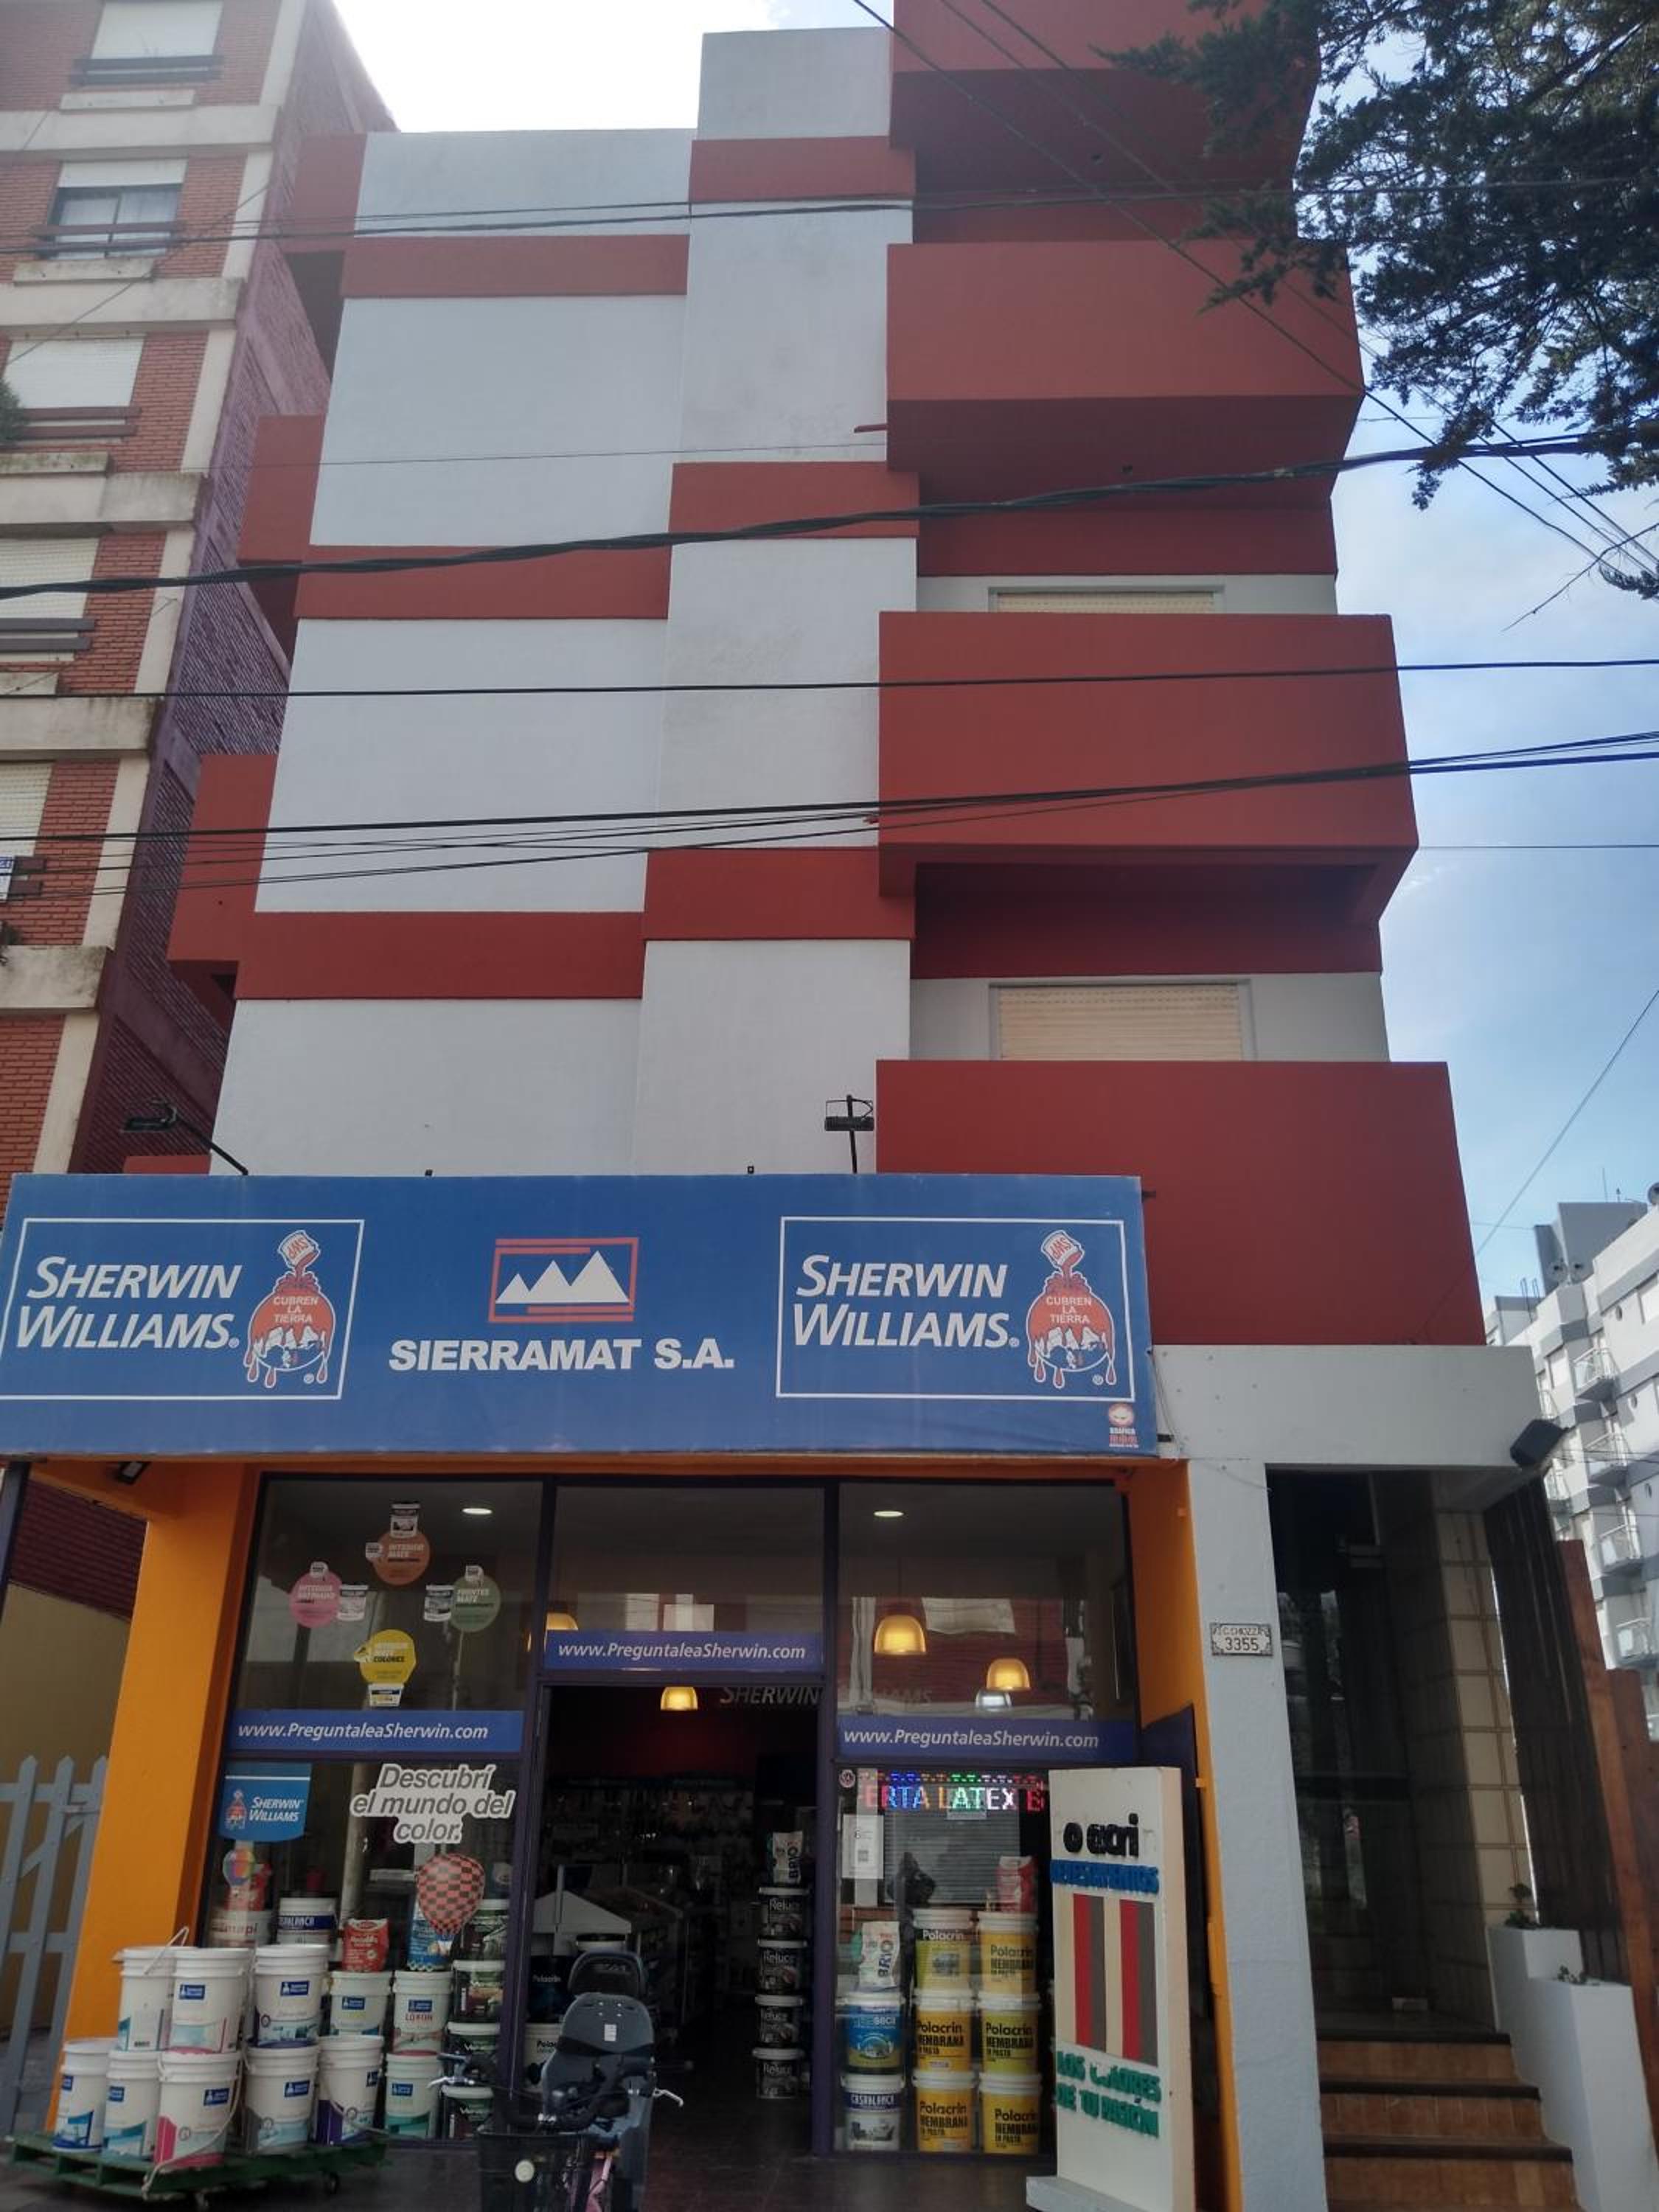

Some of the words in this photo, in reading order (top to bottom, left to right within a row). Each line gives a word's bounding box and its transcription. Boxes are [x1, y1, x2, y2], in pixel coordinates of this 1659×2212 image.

[27, 1256, 242, 1298] SHERWIN
[796, 1255, 1007, 1298] SHERWIN
[274, 1295, 319, 1306] CUBREN
[1046, 1295, 1092, 1306] CUBREN
[287, 1305, 302, 1313] LA
[1062, 1305, 1077, 1314] LA
[274, 1314, 313, 1323] TIERRA
[1050, 1315, 1091, 1324] TIERRA
[389, 1339, 641, 1370] SIERRAMAT
[655, 1339, 734, 1369] S.A.
[559, 1641, 805, 1661] www.PreguntaleaSherwin.com
[1225, 1637, 1259, 1652] 3355
[238, 1722, 488, 1741] www.PreguntaleaSherwin.com
[844, 1728, 1099, 1748] www.PreguntaleaSherwin.com
[380, 1766, 493, 1789] Descubrí
[251, 1796, 302, 1809] SHERWIN
[353, 1792, 376, 1814] el
[380, 1793, 467, 1814] mundo
[474, 1792, 514, 1815] del
[938, 1786, 1017, 1810] LATEX
[249, 1809, 299, 1822] WILLIAMS
[396, 1818, 460, 1840] color.
[922, 1928, 964, 1941] Polacrin
[918, 2021, 962, 2034] Polacrin
[986, 2023, 1032, 2036] Polacrin
[919, 2035, 964, 2048] MEMBRANA
[919, 2101, 967, 2114] Polacrin
[920, 2115, 968, 2129] MEMBRANA
